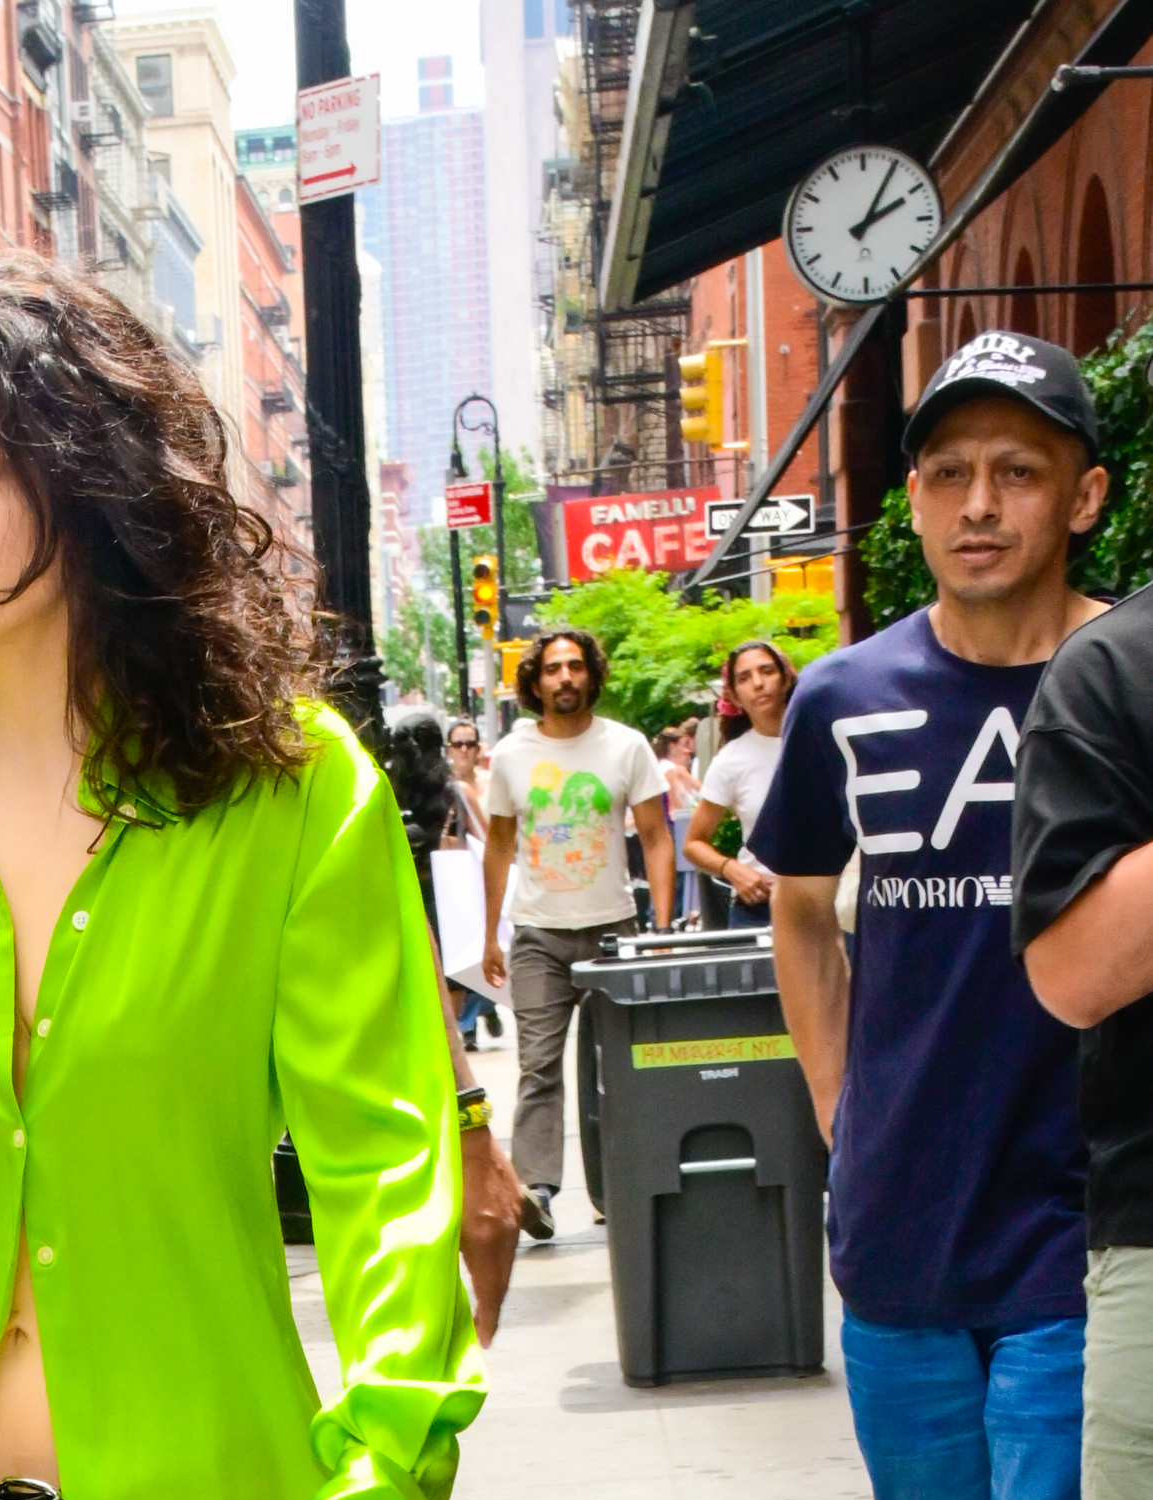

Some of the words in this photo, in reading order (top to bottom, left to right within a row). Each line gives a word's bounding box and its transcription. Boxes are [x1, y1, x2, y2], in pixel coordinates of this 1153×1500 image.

[302, 101, 315, 120] NO
[319, 88, 361, 116] PARKING
[590, 496, 696, 525] FANELLI
[717, 512, 741, 530] ON
[760, 508, 792, 523] WAY
[581, 522, 711, 573] CAFE
[699, 1067, 739, 1080] TRASH
